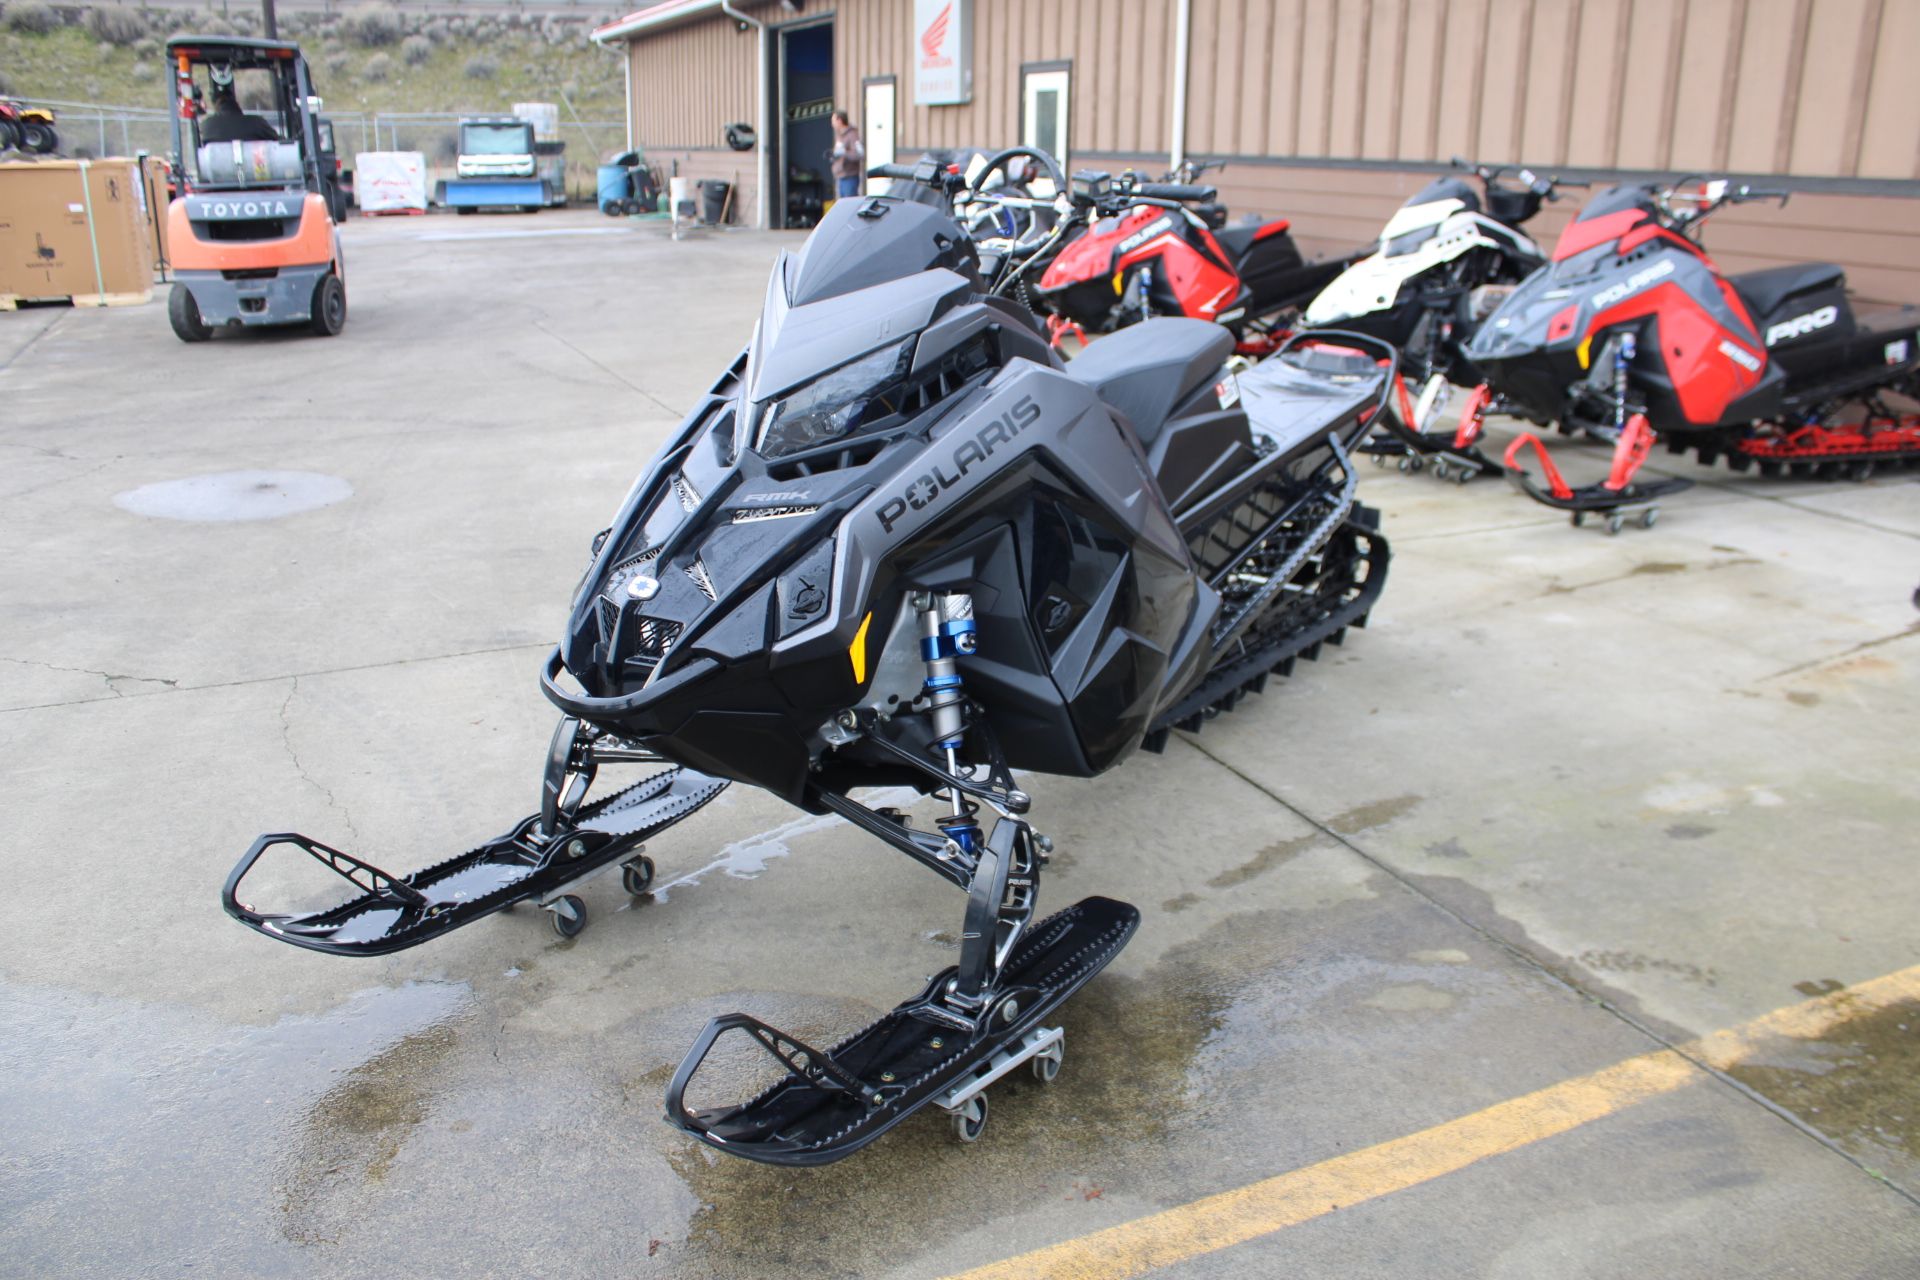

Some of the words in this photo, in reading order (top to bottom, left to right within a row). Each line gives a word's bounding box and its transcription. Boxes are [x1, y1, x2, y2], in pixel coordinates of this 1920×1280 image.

[201, 201, 288, 217] TOYOTA
[1592, 259, 1676, 310] POLARIS
[1766, 306, 1838, 347] PRO
[875, 394, 1041, 535] POLARIS
[742, 490, 812, 503] RMK
